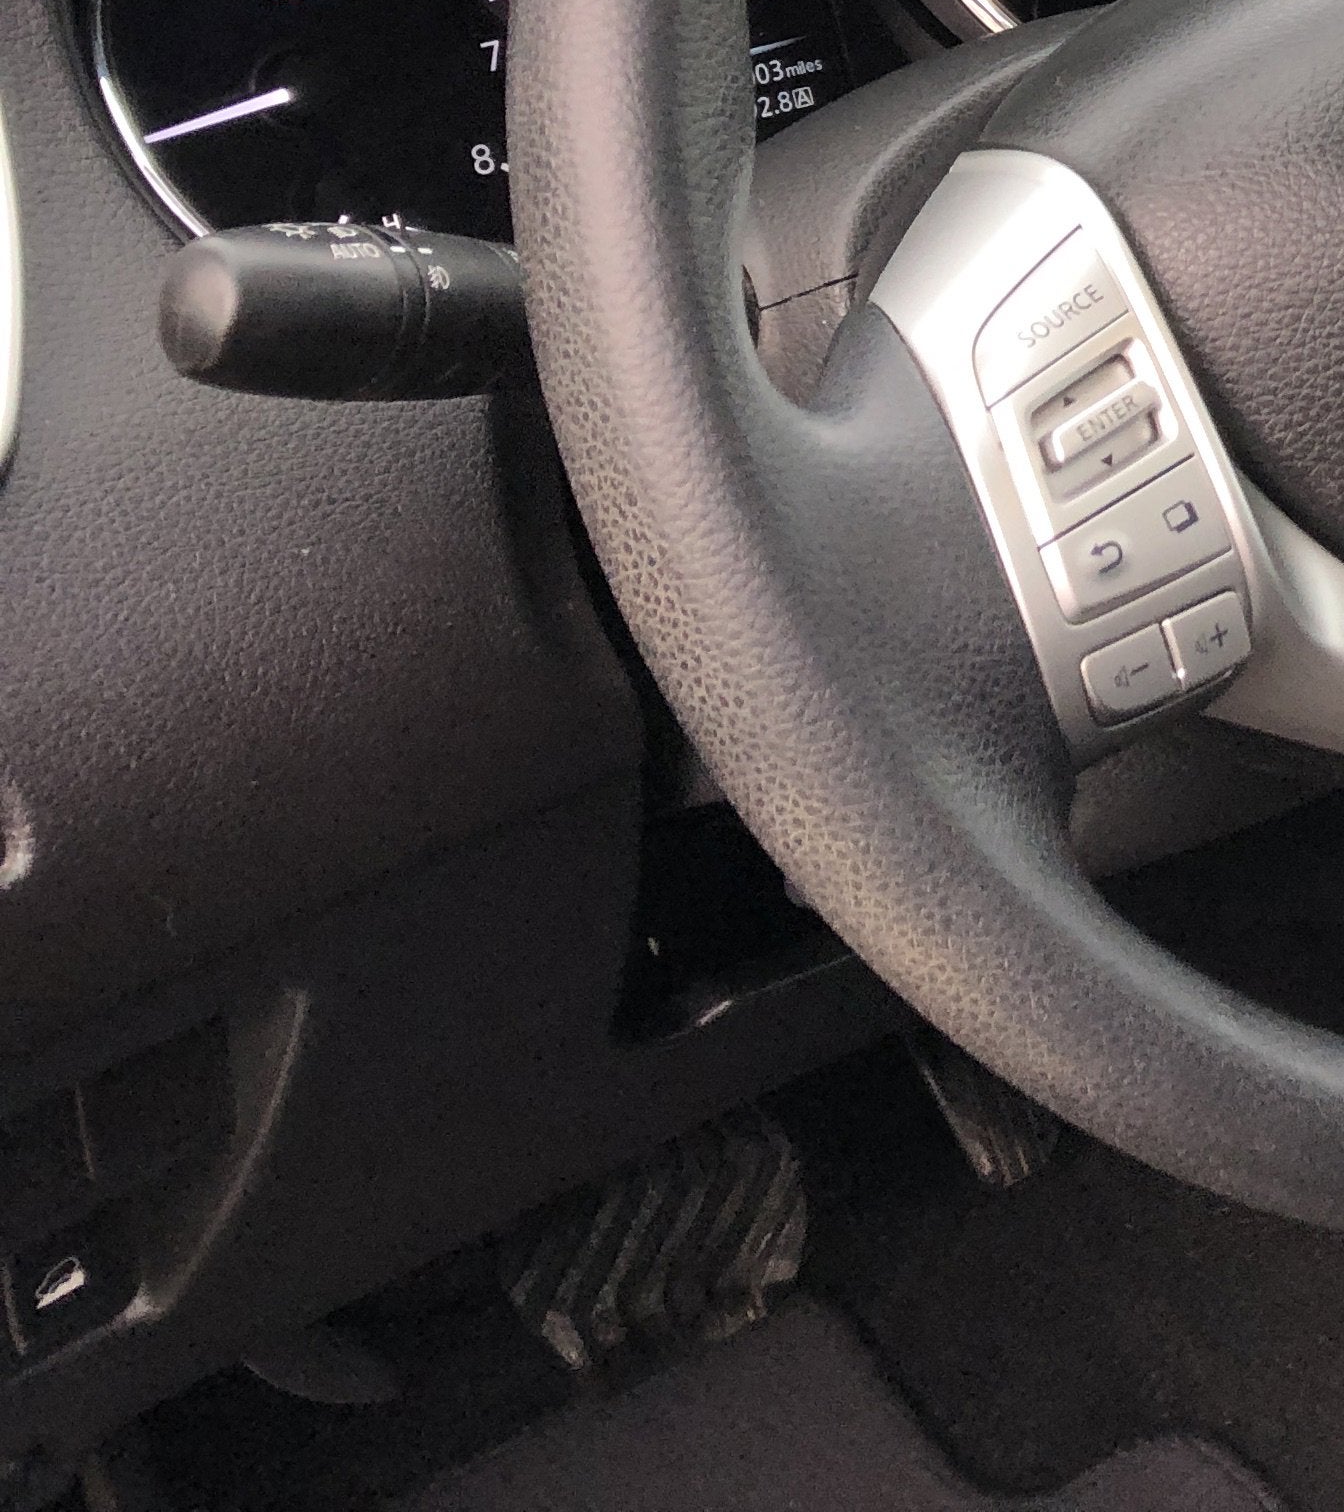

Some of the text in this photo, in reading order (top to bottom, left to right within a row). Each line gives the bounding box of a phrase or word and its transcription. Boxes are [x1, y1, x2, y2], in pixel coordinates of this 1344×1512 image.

[480, 39, 500, 72] 7
[754, 90, 793, 119] 2.8
[471, 143, 496, 176] 8
[330, 243, 381, 260] AUTO
[1017, 284, 1105, 348] SOURCE
[1076, 394, 1139, 442] ENTER
